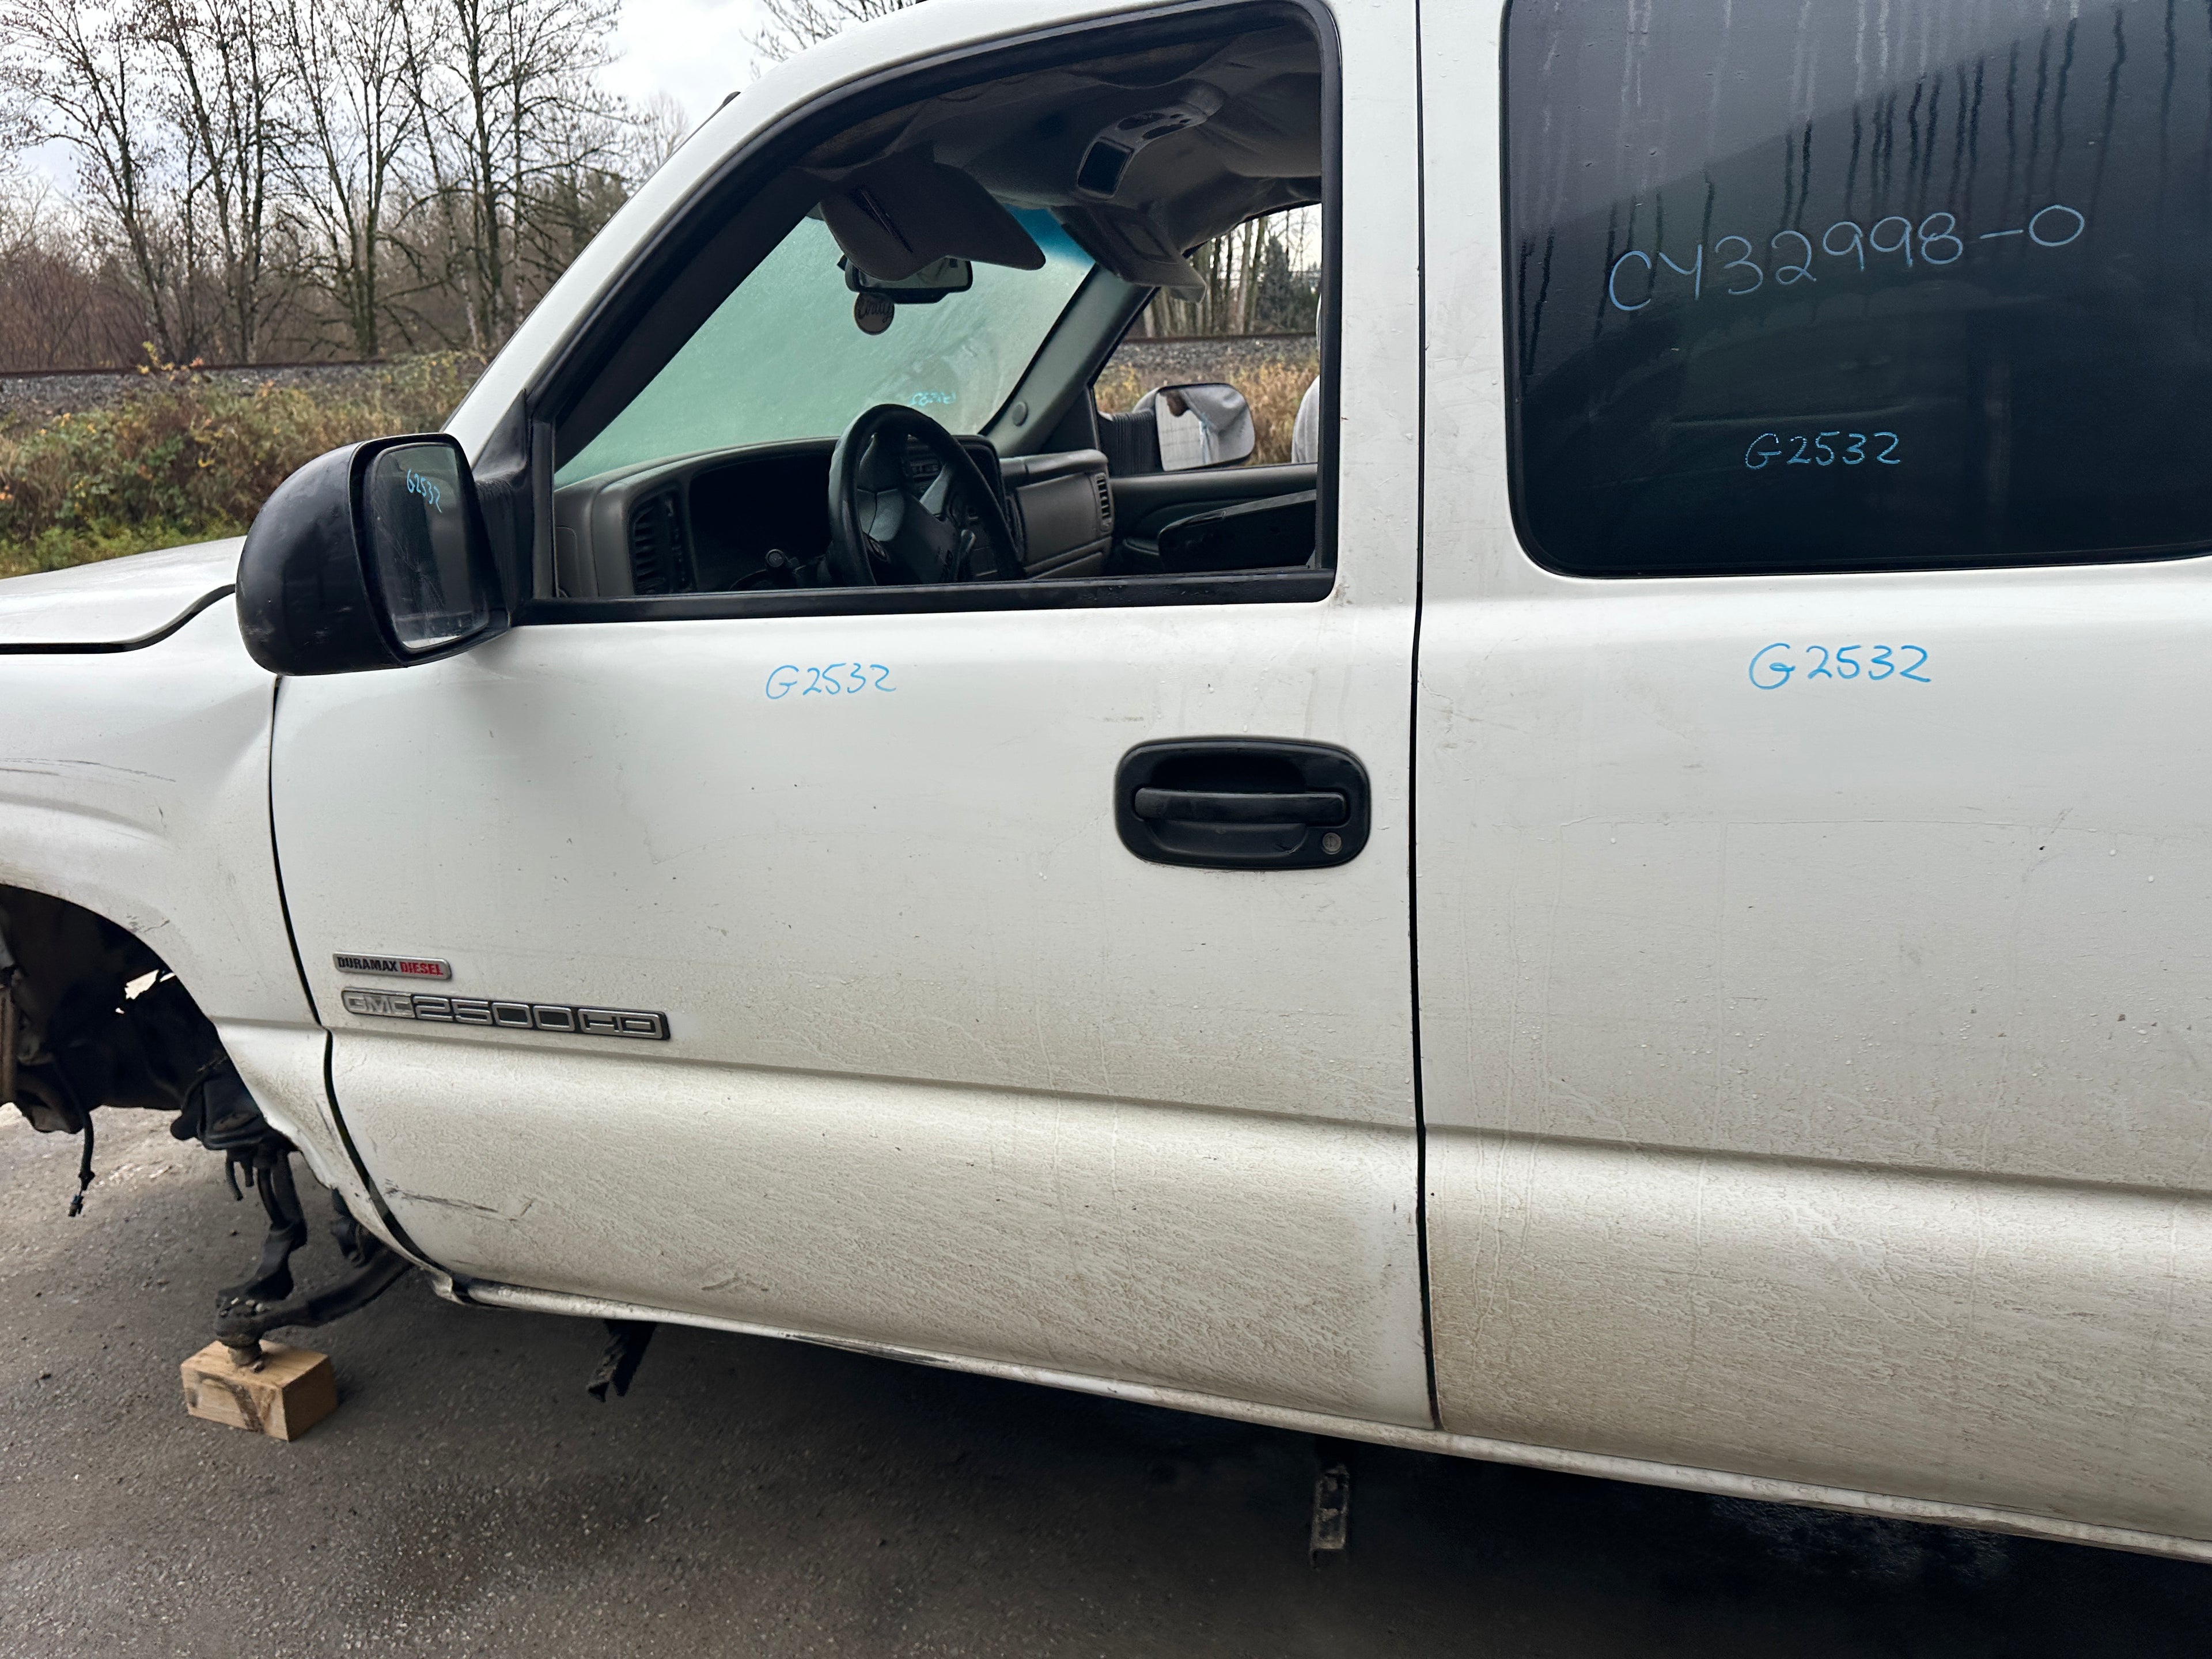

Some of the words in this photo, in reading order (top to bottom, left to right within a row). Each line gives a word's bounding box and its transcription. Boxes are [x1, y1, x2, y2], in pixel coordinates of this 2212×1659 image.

[1745, 431, 1900, 469] G2532
[407, 468, 442, 513] G2532
[766, 662, 896, 699] G2532
[1749, 643, 1931, 690] G2532
[337, 957, 398, 972] DURAMAX
[399, 961, 444, 975] DIESEL
